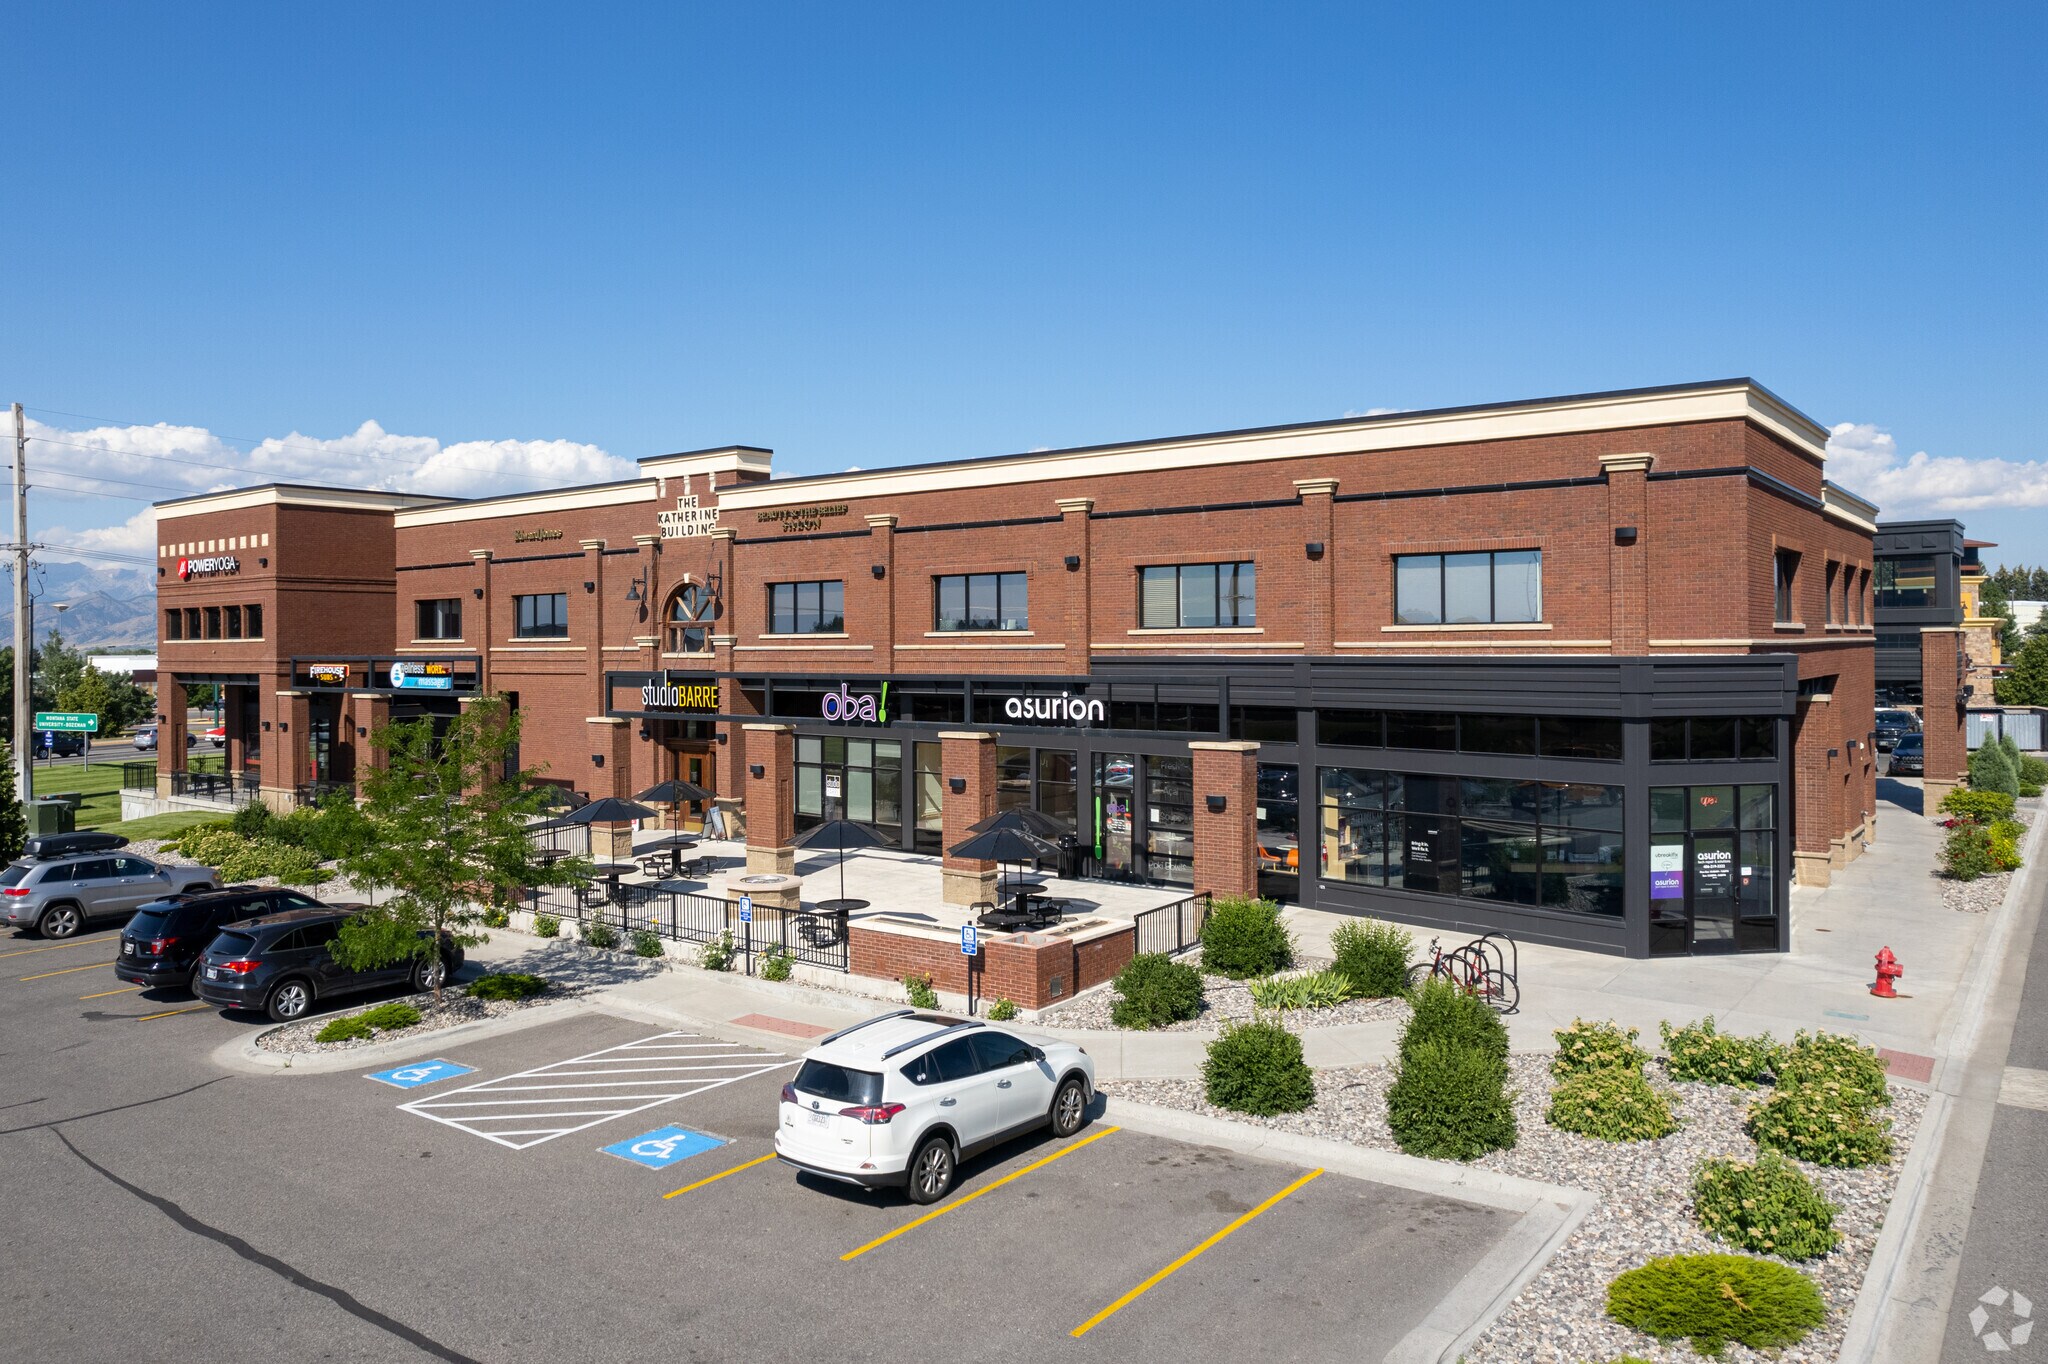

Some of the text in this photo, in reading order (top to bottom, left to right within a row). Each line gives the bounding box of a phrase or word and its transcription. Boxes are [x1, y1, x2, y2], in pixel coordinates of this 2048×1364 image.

[678, 497, 697, 508] THE
[657, 508, 718, 524] KATHERINE
[661, 523, 715, 538] BUILDING
[310, 666, 345, 678] FIREHOUSE
[320, 673, 334, 681] SUBS
[1004, 691, 1104, 721] asurion
[1697, 850, 1731, 860] asurion
[1655, 878, 1680, 886] asurion
